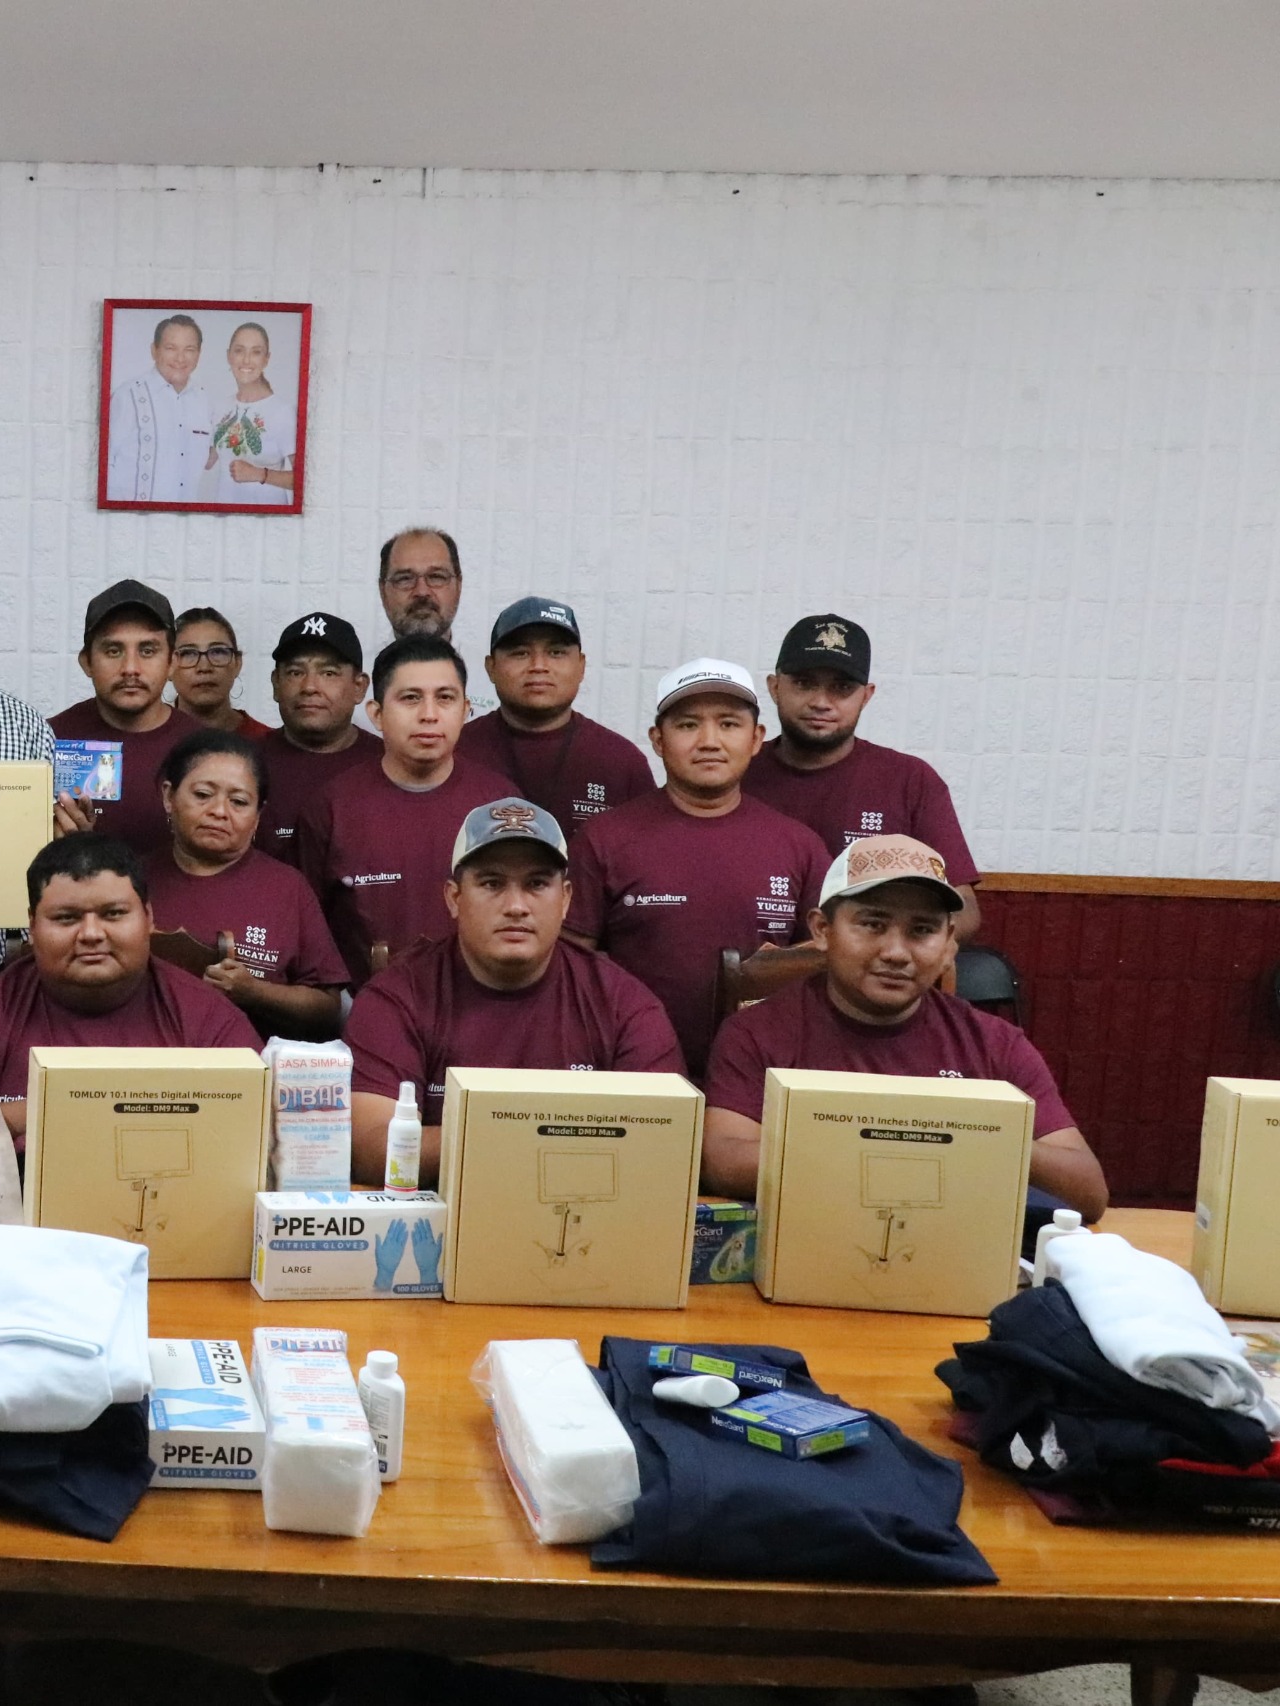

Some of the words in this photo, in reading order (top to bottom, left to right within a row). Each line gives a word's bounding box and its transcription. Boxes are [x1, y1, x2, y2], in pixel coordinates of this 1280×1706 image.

[55, 752, 93, 762] NexGard
[573, 804, 606, 813] YUCAT
[354, 872, 402, 884] Agricultura
[636, 894, 687, 905] Agricultura
[757, 902, 796, 912] YUCATÁN
[310, 1057, 351, 1068] SIMPLE
[69, 1090, 107, 1099] TOMLOV
[110, 1090, 127, 1099] 10.1
[130, 1090, 159, 1099] Inches
[161, 1090, 191, 1102] Digital
[192, 1090, 243, 1102] Microscope
[123, 1104, 151, 1112] Model:
[153, 1104, 170, 1112] DM9
[172, 1104, 190, 1112] Max
[491, 1111, 530, 1121] TOMLOV
[533, 1113, 551, 1121] 10.1
[554, 1113, 584, 1122] Inches
[587, 1114, 617, 1125] Digital
[619, 1115, 672, 1126] Microscope
[812, 1113, 853, 1123] TOMLOV
[856, 1114, 875, 1124] 10.1
[877, 1115, 908, 1126] Inches
[911, 1117, 943, 1130] Digital
[945, 1119, 1002, 1133] Microscope
[547, 1127, 576, 1135] Model:
[577, 1127, 597, 1136] DM9
[599, 1128, 617, 1137] Max
[870, 1130, 900, 1140] Model:
[902, 1131, 922, 1141] DM9
[924, 1132, 943, 1142] Max
[274, 1216, 365, 1236] PPE-AID
[273, 1241, 317, 1249] NITRILE
[323, 1241, 366, 1250] GLOVES
[282, 1265, 313, 1274] LARGE
[209, 1341, 242, 1384] PPE-AID
[739, 1371, 783, 1388] NexGard
[711, 1415, 744, 1433] NexGard
[163, 1445, 253, 1465] PPE-AID
[161, 1468, 207, 1477] NITRILE
[211, 1469, 254, 1478] GLOVES
